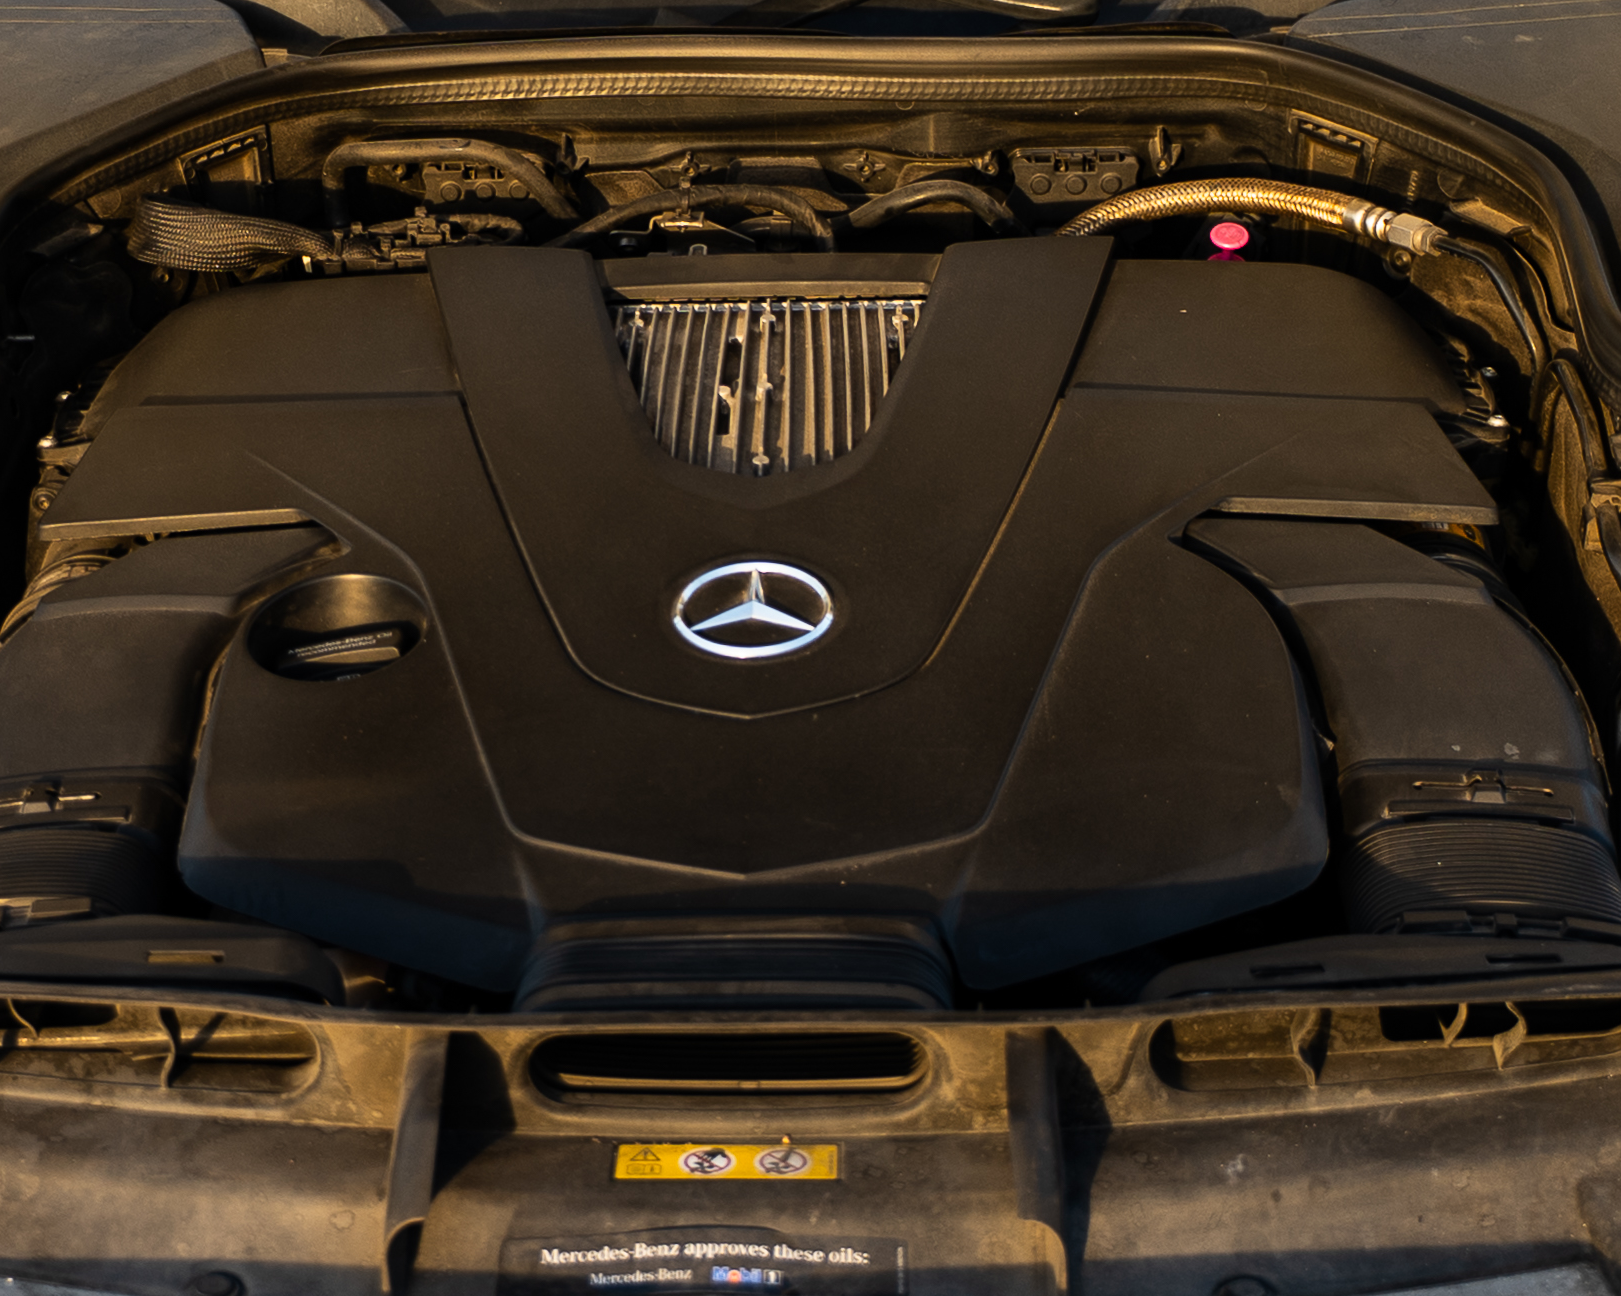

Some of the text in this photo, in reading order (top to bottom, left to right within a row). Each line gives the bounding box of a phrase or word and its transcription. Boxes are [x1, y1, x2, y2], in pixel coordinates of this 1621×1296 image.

[540, 1243, 871, 1265] Mercedes-Benz approves these oils:
[590, 1268, 693, 1285] Mercedes-Benz
[711, 1266, 762, 1284] Mobil
